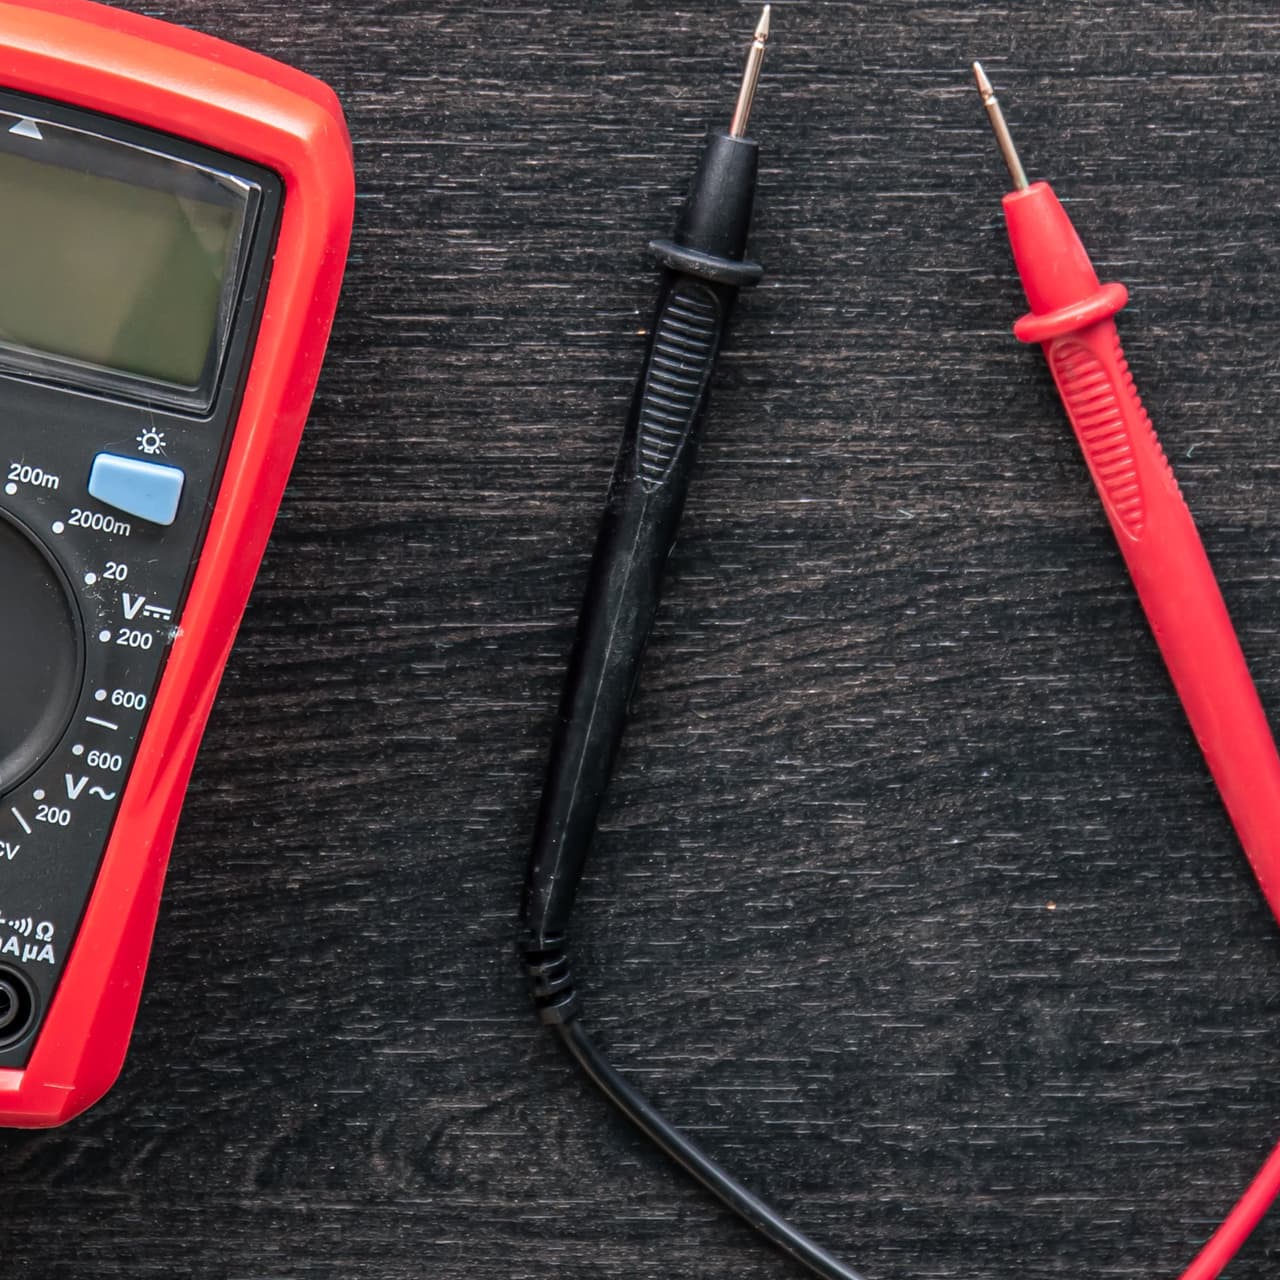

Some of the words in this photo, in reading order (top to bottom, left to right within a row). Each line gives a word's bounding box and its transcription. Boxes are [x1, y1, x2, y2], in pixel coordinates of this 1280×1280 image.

[8, 463, 60, 490] 200m
[68, 509, 130, 536] 2000m
[103, 562, 127, 580] 20
[117, 629, 152, 649] 200
[112, 690, 146, 710] 600
[88, 751, 122, 771] 600
[36, 805, 70, 825] 200
